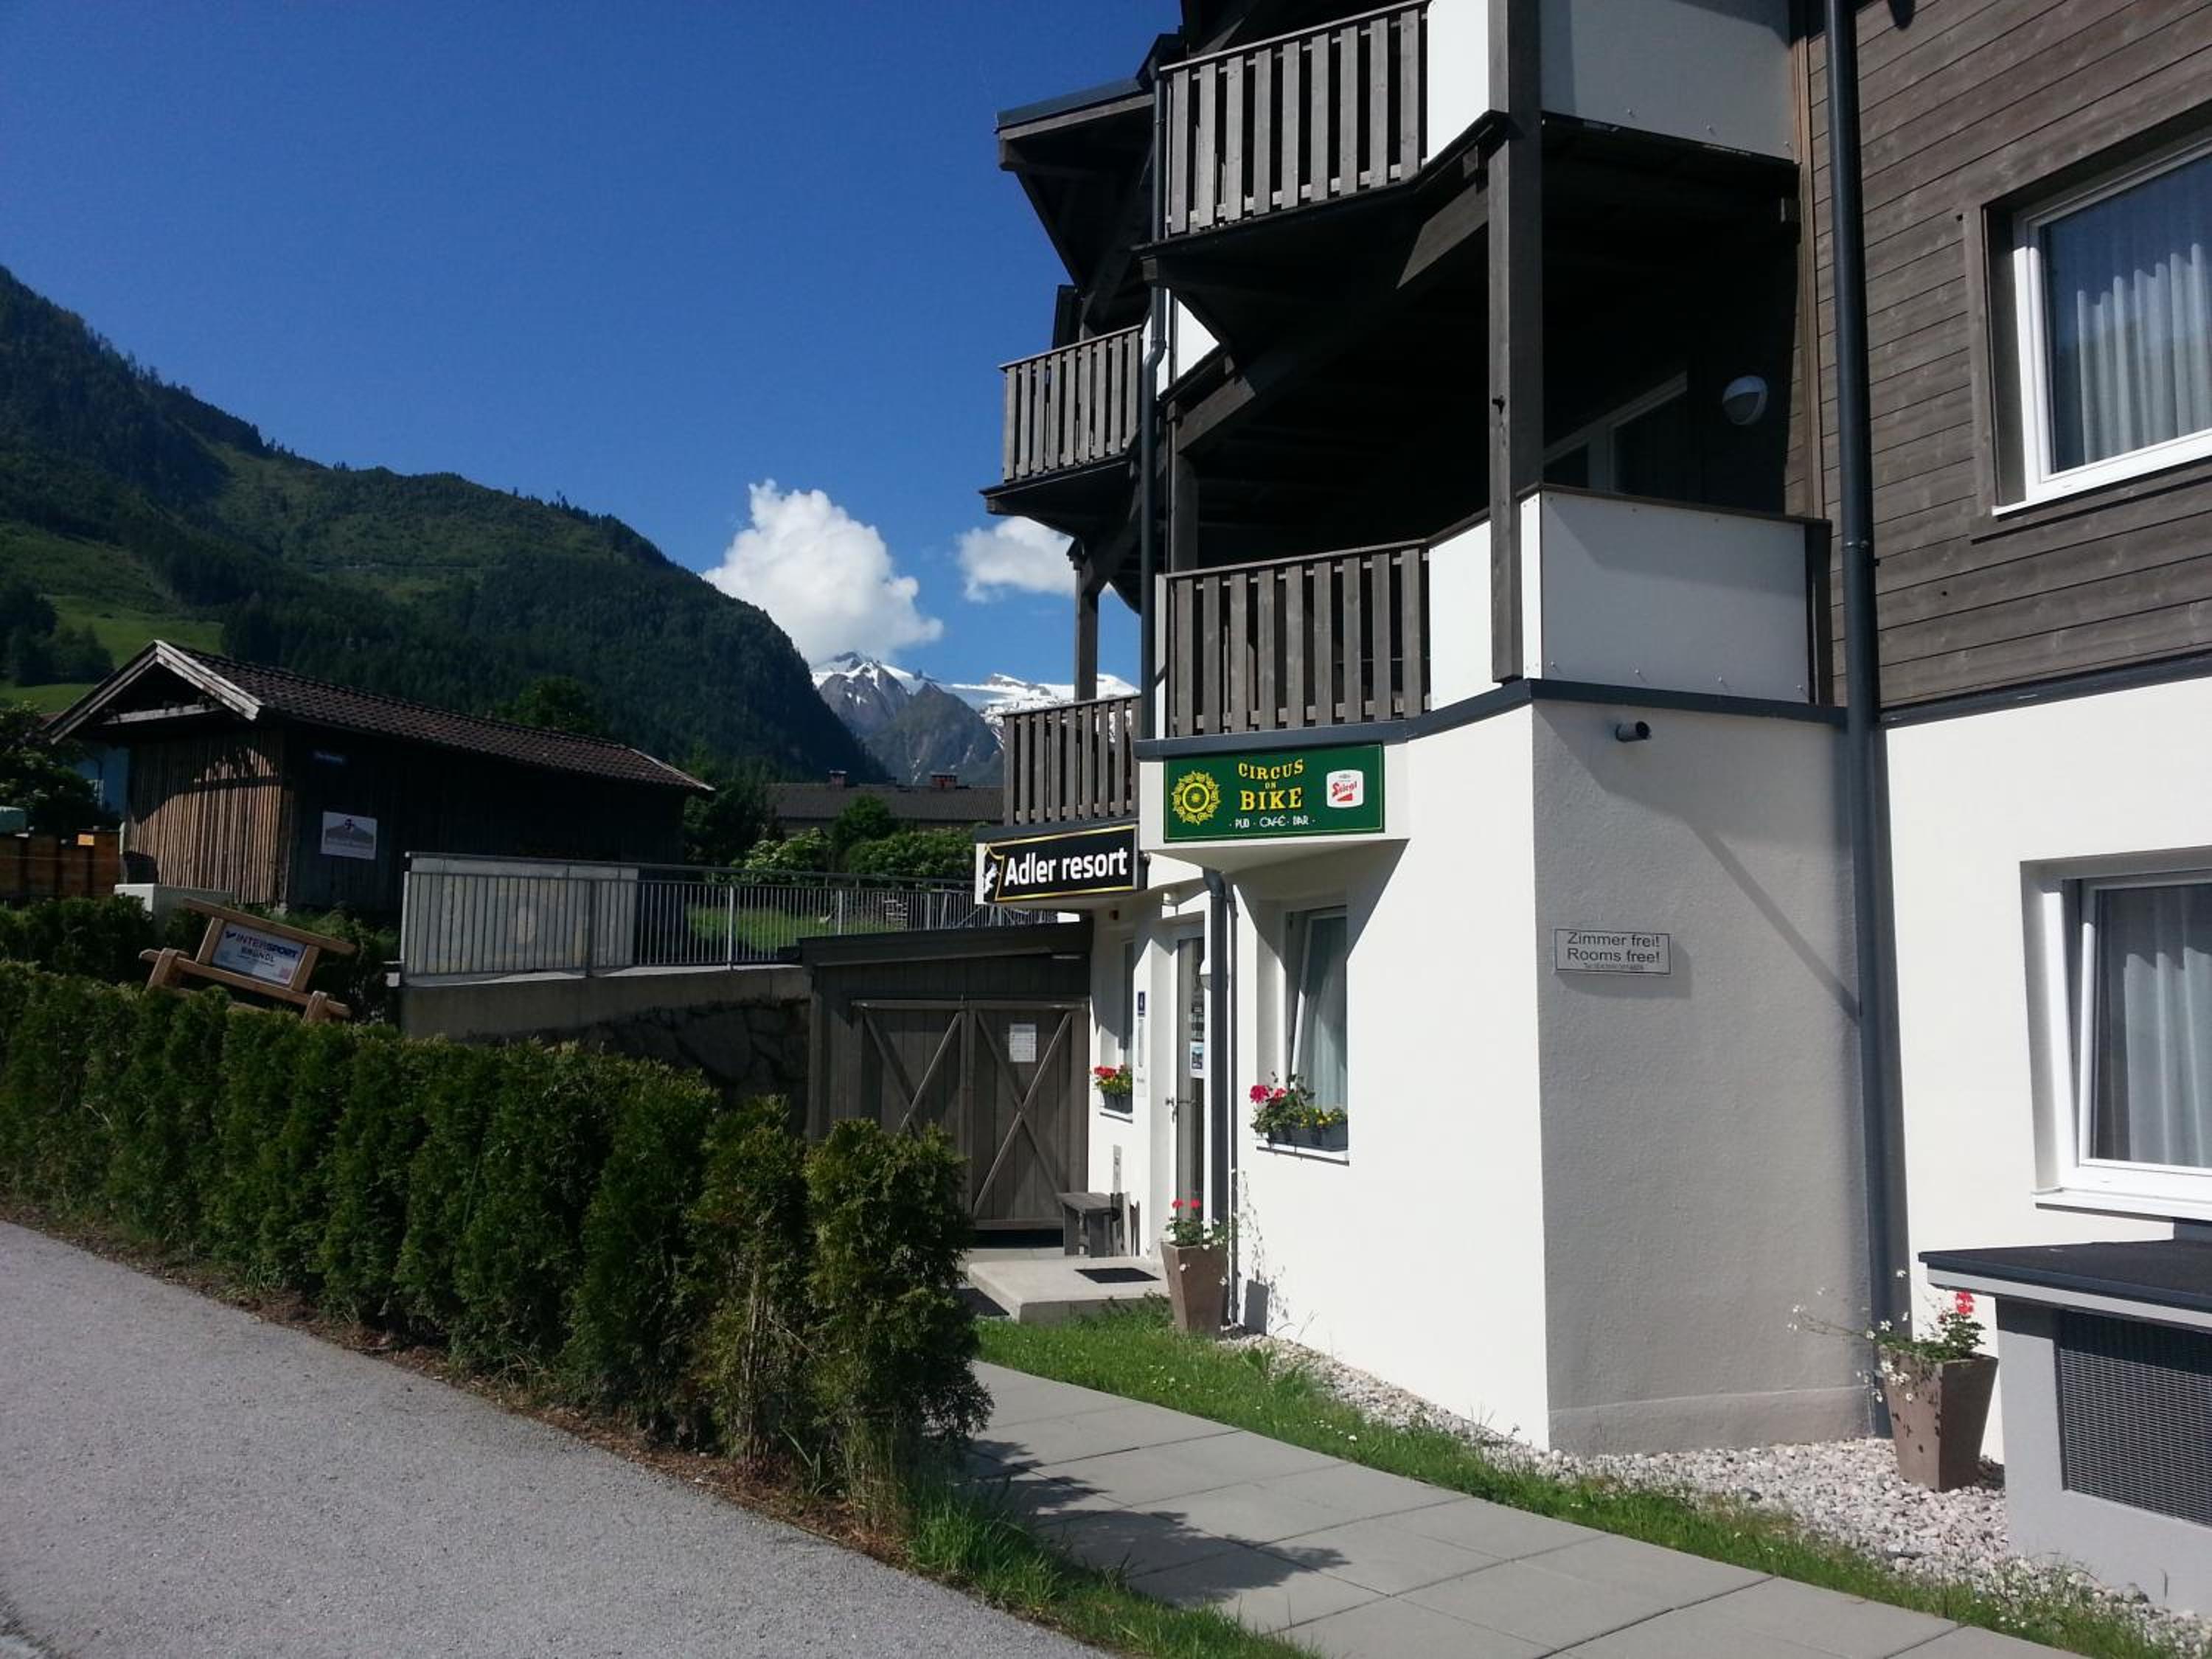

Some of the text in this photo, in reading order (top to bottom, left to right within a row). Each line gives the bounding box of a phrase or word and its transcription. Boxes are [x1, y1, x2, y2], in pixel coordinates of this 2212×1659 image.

[1238, 759, 1304, 779] CIRCUS
[1265, 781, 1276, 790] ON
[1240, 787, 1301, 811] BIKE
[1235, 818, 1250, 829] PUB
[1293, 815, 1310, 826] BAR
[1004, 847, 1128, 886] Adler resort
[236, 932, 299, 957] INTERSPORT
[1568, 931, 1660, 947] Zimmer frei!
[1568, 947, 1621, 962] Rooms
